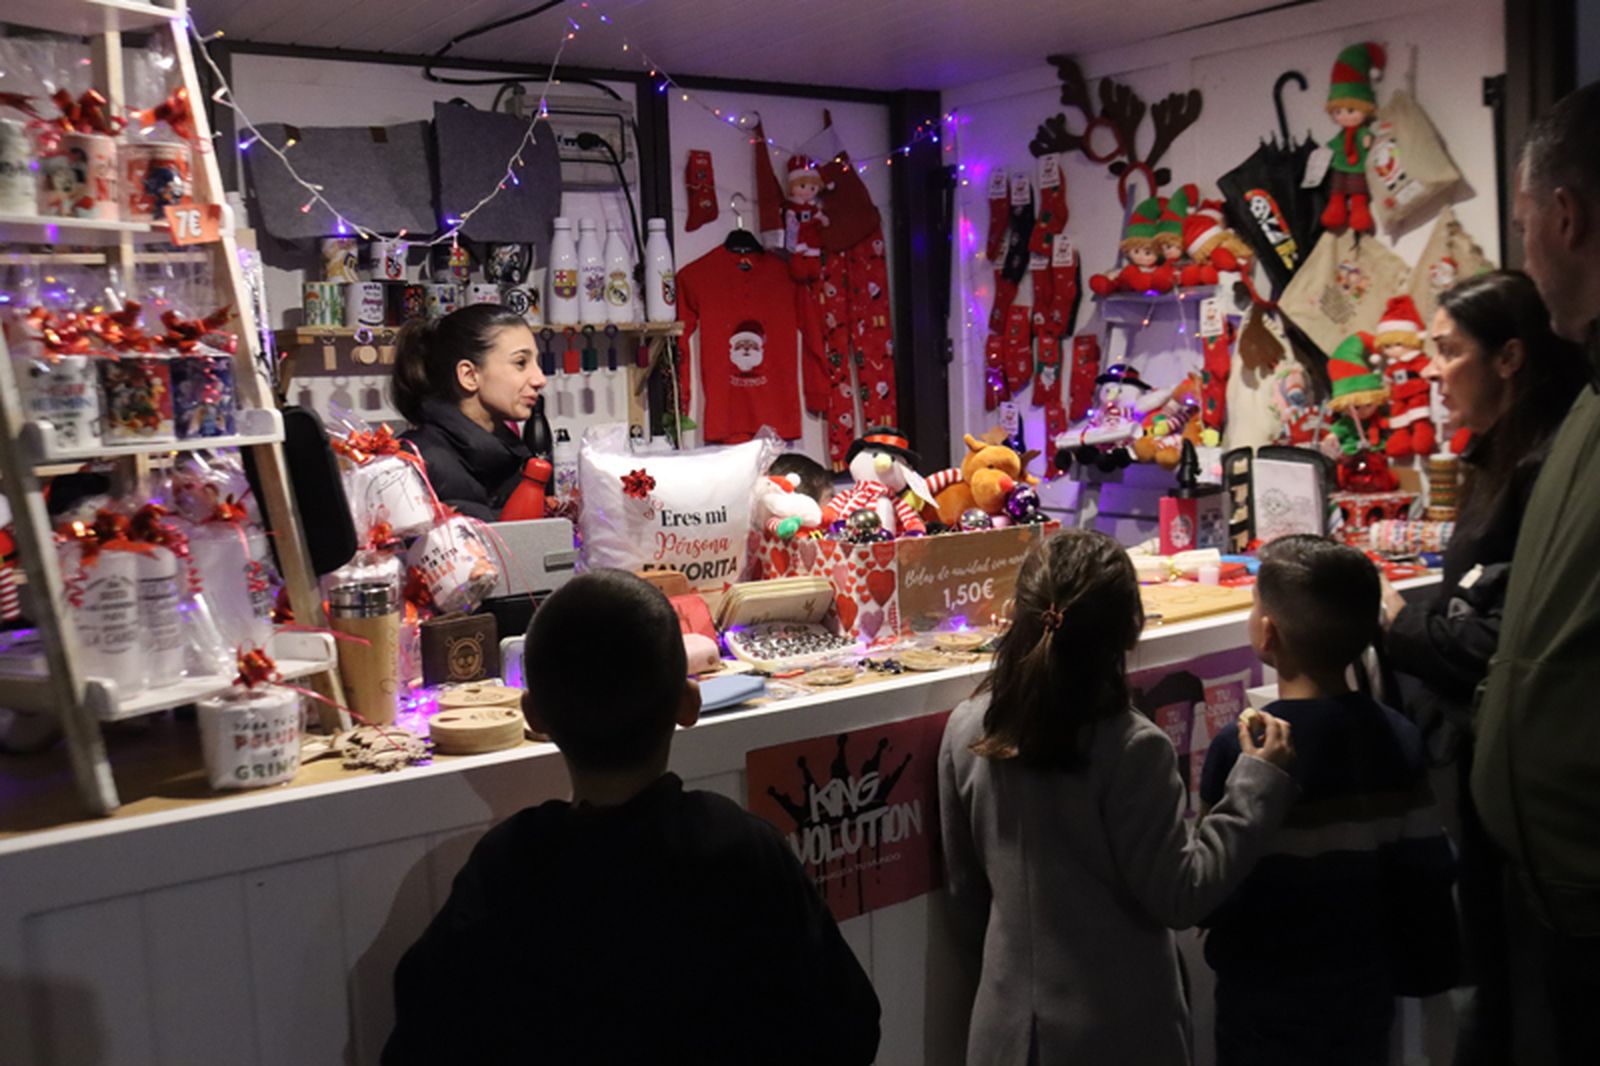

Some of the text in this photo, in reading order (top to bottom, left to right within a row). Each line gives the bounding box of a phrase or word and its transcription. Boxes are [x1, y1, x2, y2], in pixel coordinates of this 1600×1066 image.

[176, 209, 202, 239] 7€
[661, 505, 727, 527] Eres mi
[654, 531, 729, 560] Persona
[943, 578, 995, 611] 1,50€
[808, 771, 879, 823] KING
[785, 799, 923, 866] VOLUTION
